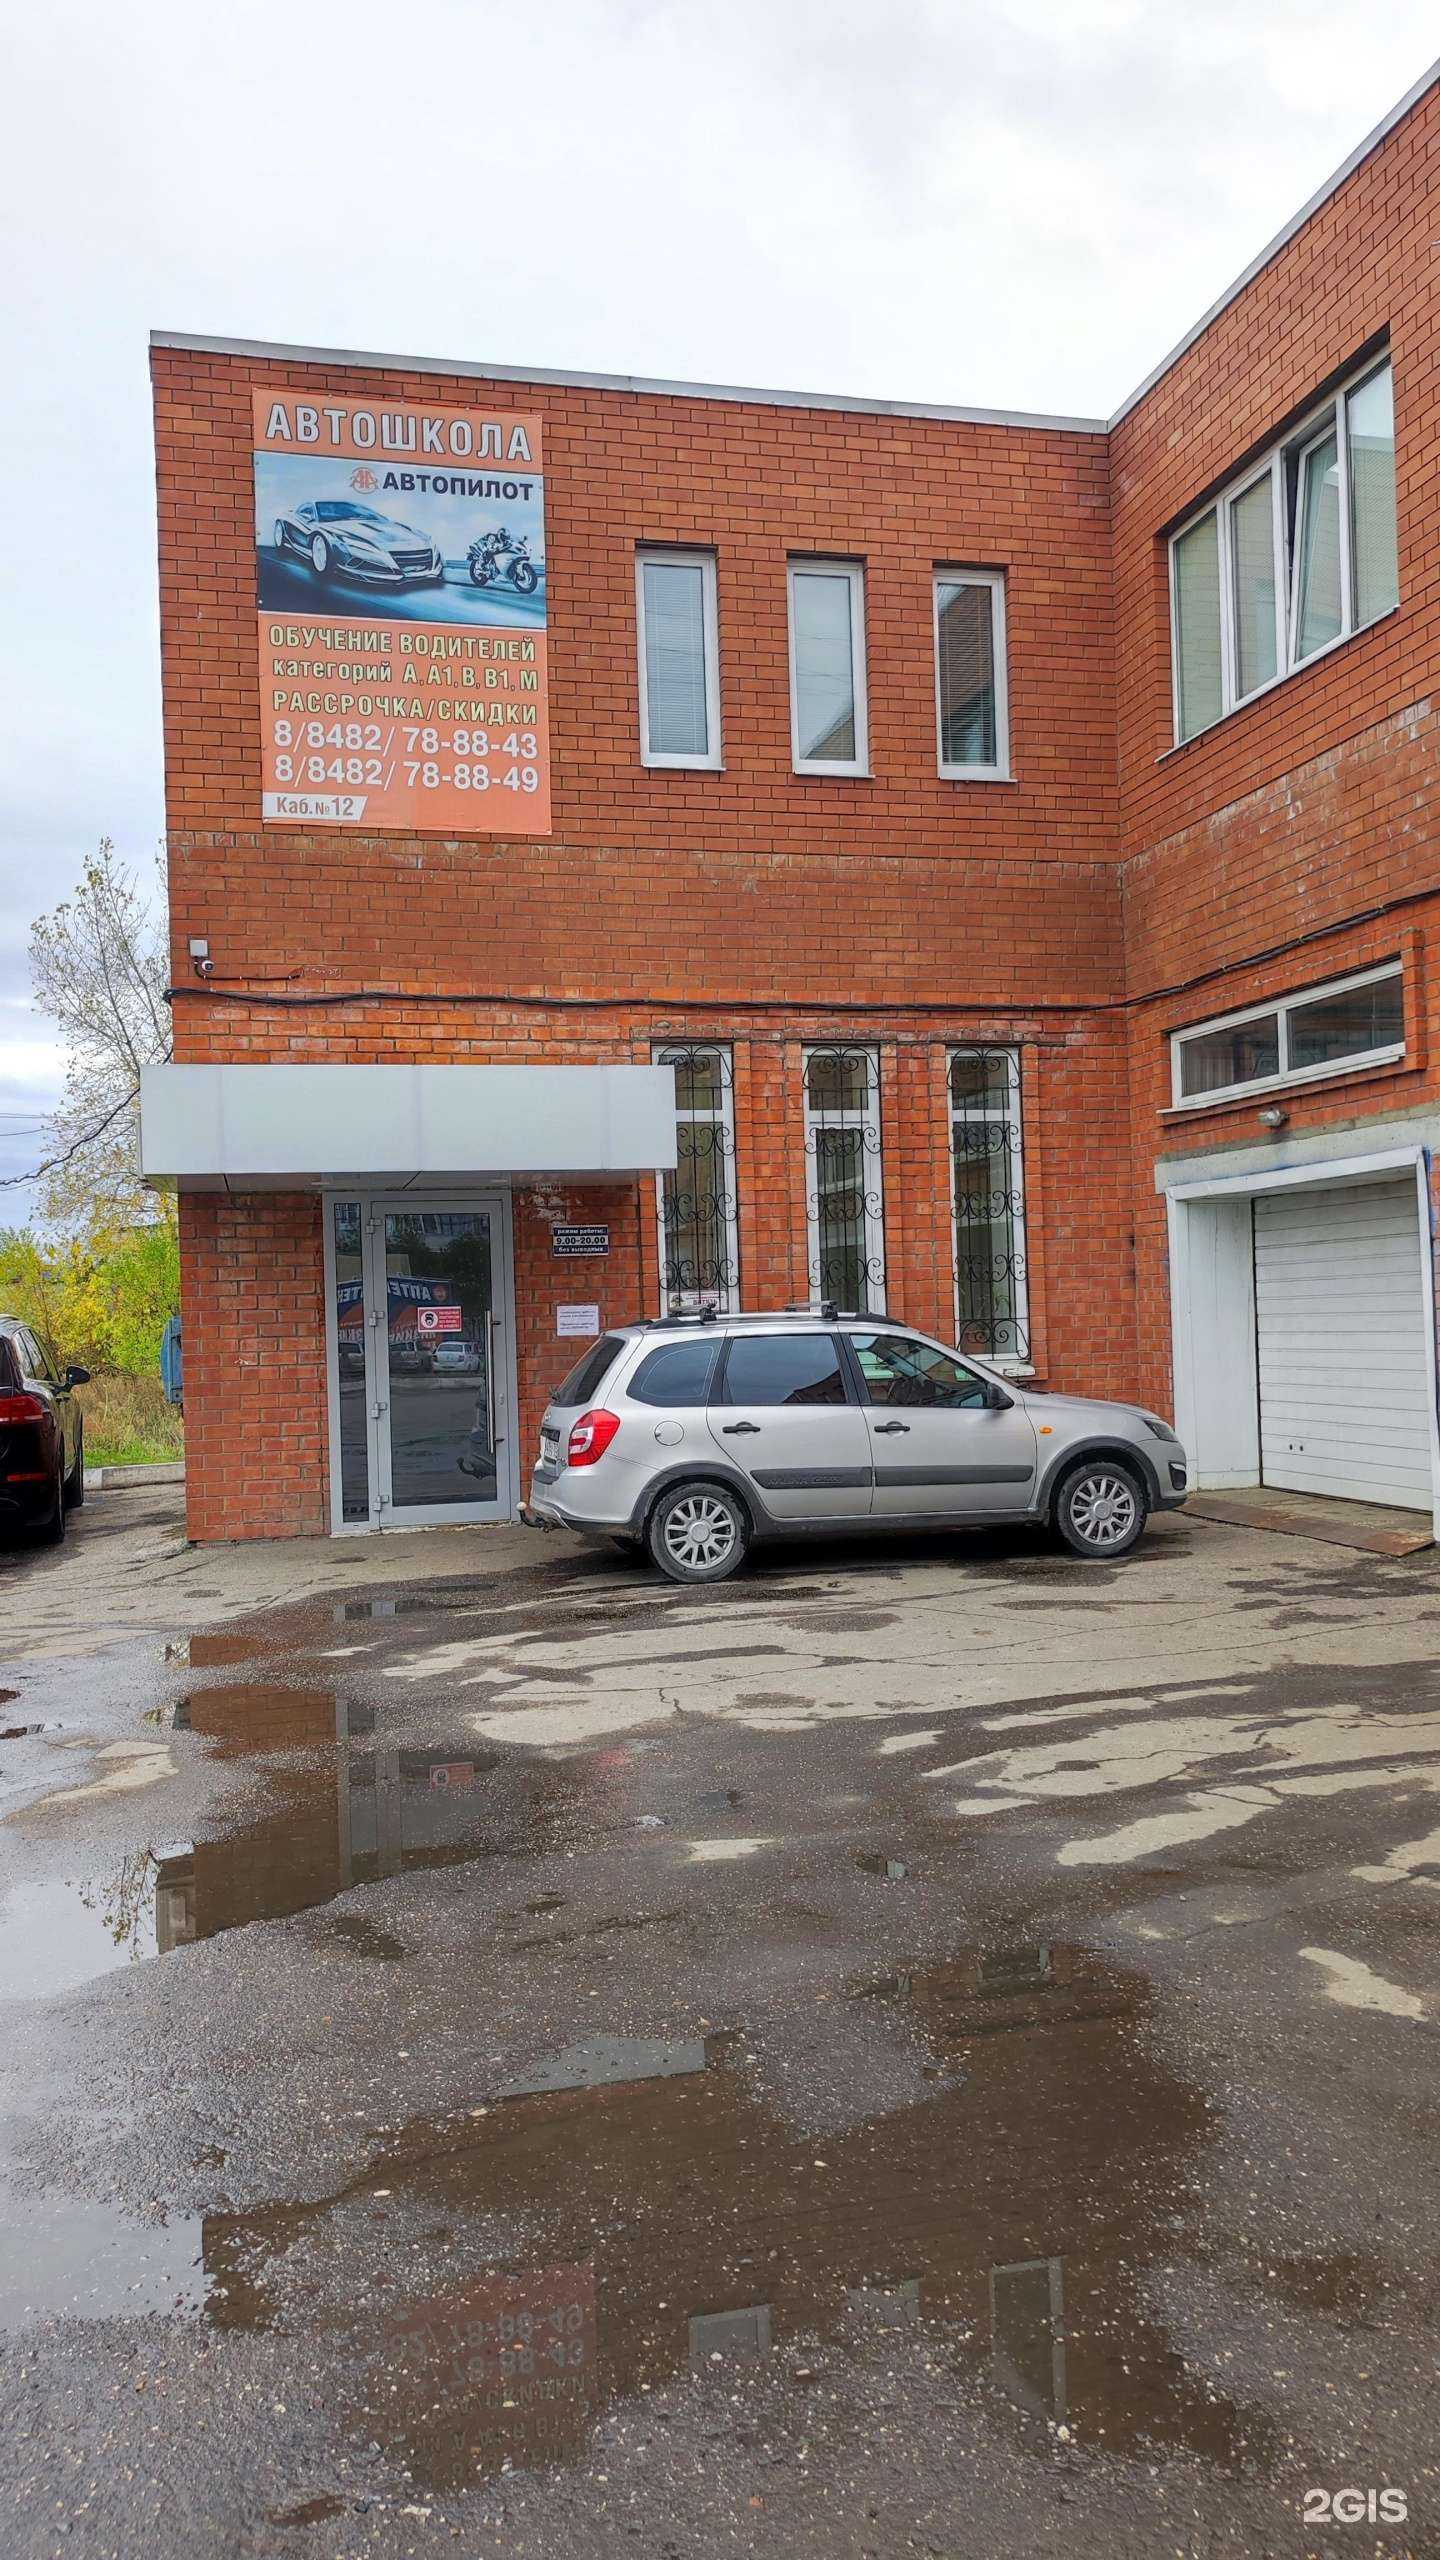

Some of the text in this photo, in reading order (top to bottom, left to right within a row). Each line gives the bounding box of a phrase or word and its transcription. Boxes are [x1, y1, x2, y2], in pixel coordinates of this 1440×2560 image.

[266, 403, 532, 462] АВТОШКОЛА
[382, 471, 533, 501] АВТОПИЛОТ
[270, 624, 535, 662] ОБУЧЕНИЕ ВОДИТЕЛЕЙ
[273, 659, 392, 685] категорий
[273, 690, 537, 726] РАССРОЧКА/СКИДКИ
